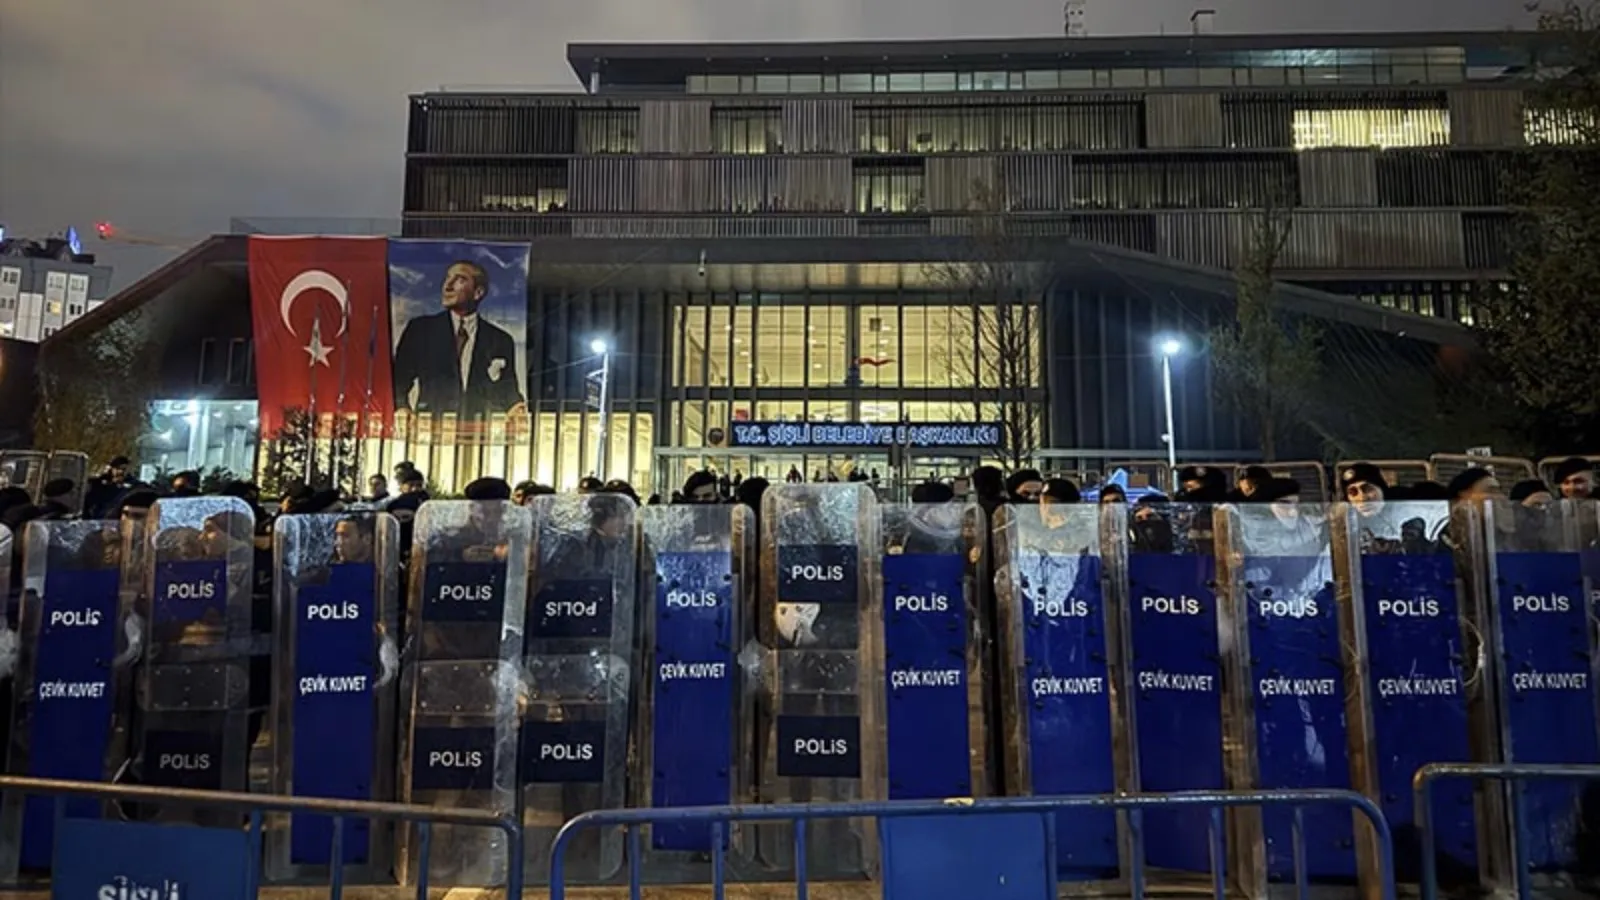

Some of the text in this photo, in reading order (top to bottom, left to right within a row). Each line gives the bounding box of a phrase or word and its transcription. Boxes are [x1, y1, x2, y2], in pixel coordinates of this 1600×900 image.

[688, 662, 726, 679] KUVVET
[921, 669, 961, 687] KUVVET
[67, 681, 106, 698] KUVVET
[329, 675, 367, 692] KUVVET
[1063, 677, 1103, 695] KUVVET
[1171, 672, 1213, 692] KUVVET
[1293, 679, 1335, 697] KUVVET
[1413, 677, 1457, 695] KUVVET
[1545, 672, 1587, 689] KUVVET
